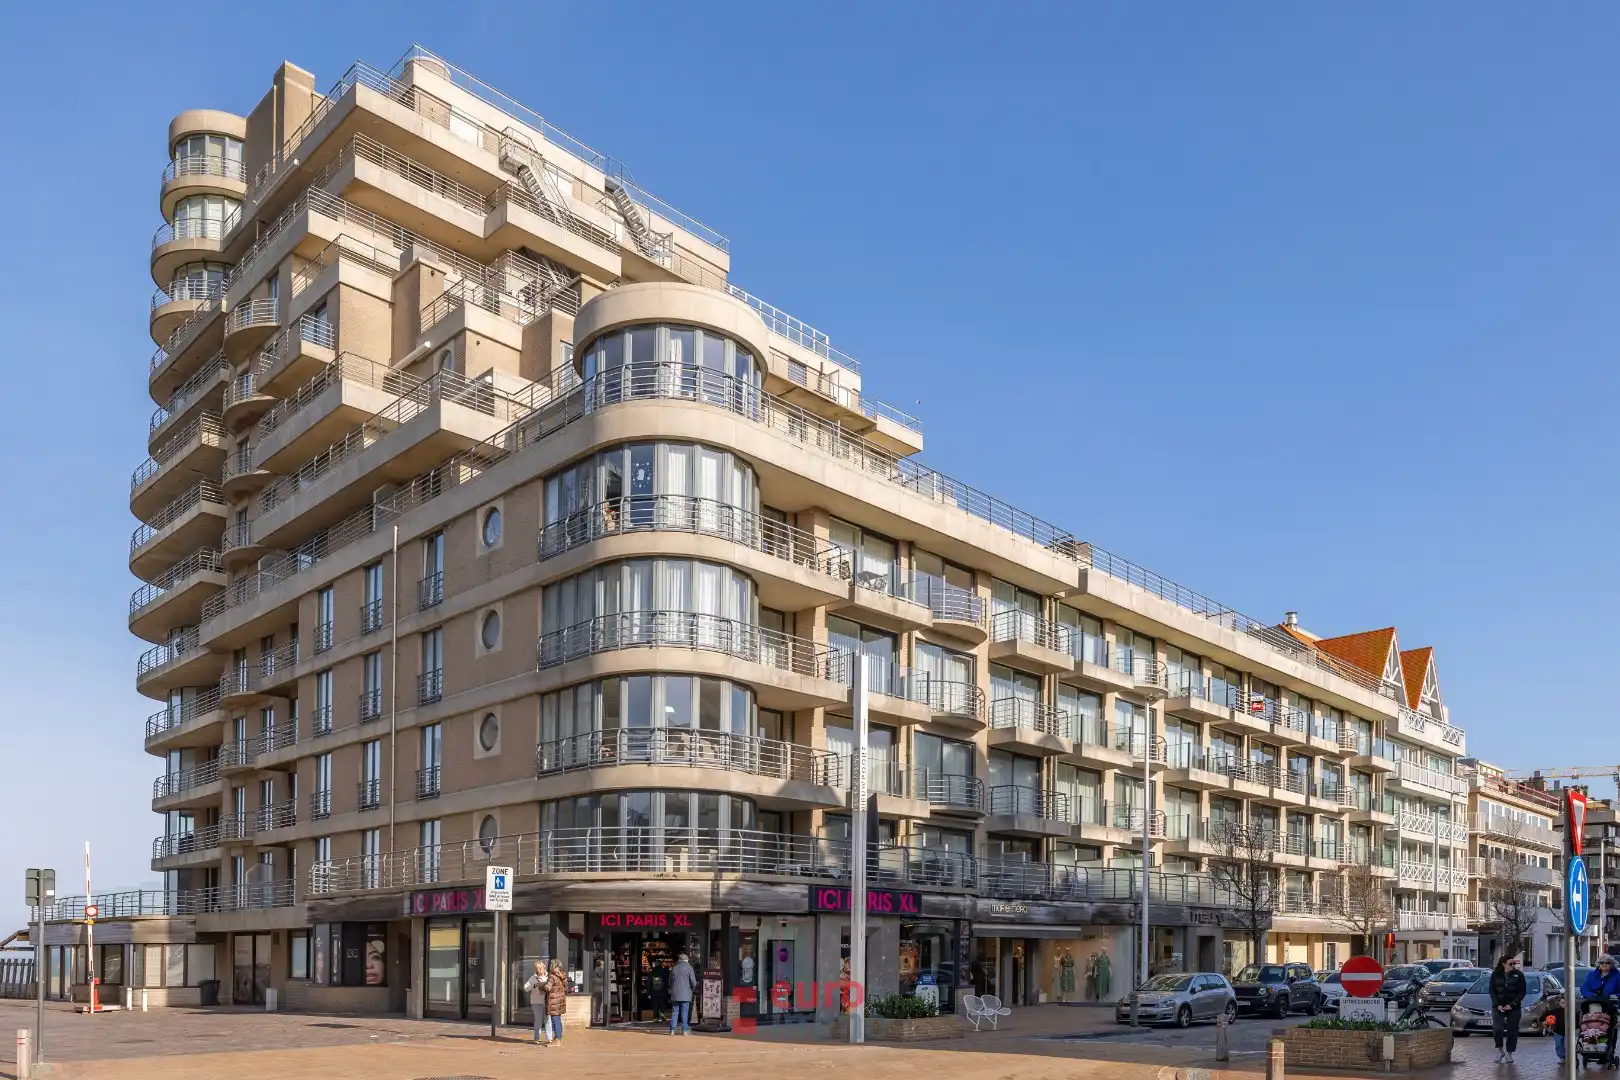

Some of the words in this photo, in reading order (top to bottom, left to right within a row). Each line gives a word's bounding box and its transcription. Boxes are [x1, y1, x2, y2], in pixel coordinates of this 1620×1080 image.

[413, 893, 429, 914] ICI
[433, 890, 468, 911] PARIS
[818, 889, 842, 909] ICI
[846, 890, 893, 911] RIS
[899, 893, 918, 913] XL
[601, 914, 621, 927] ICI
[625, 914, 667, 927] PARIS
[674, 914, 692, 927] XL
